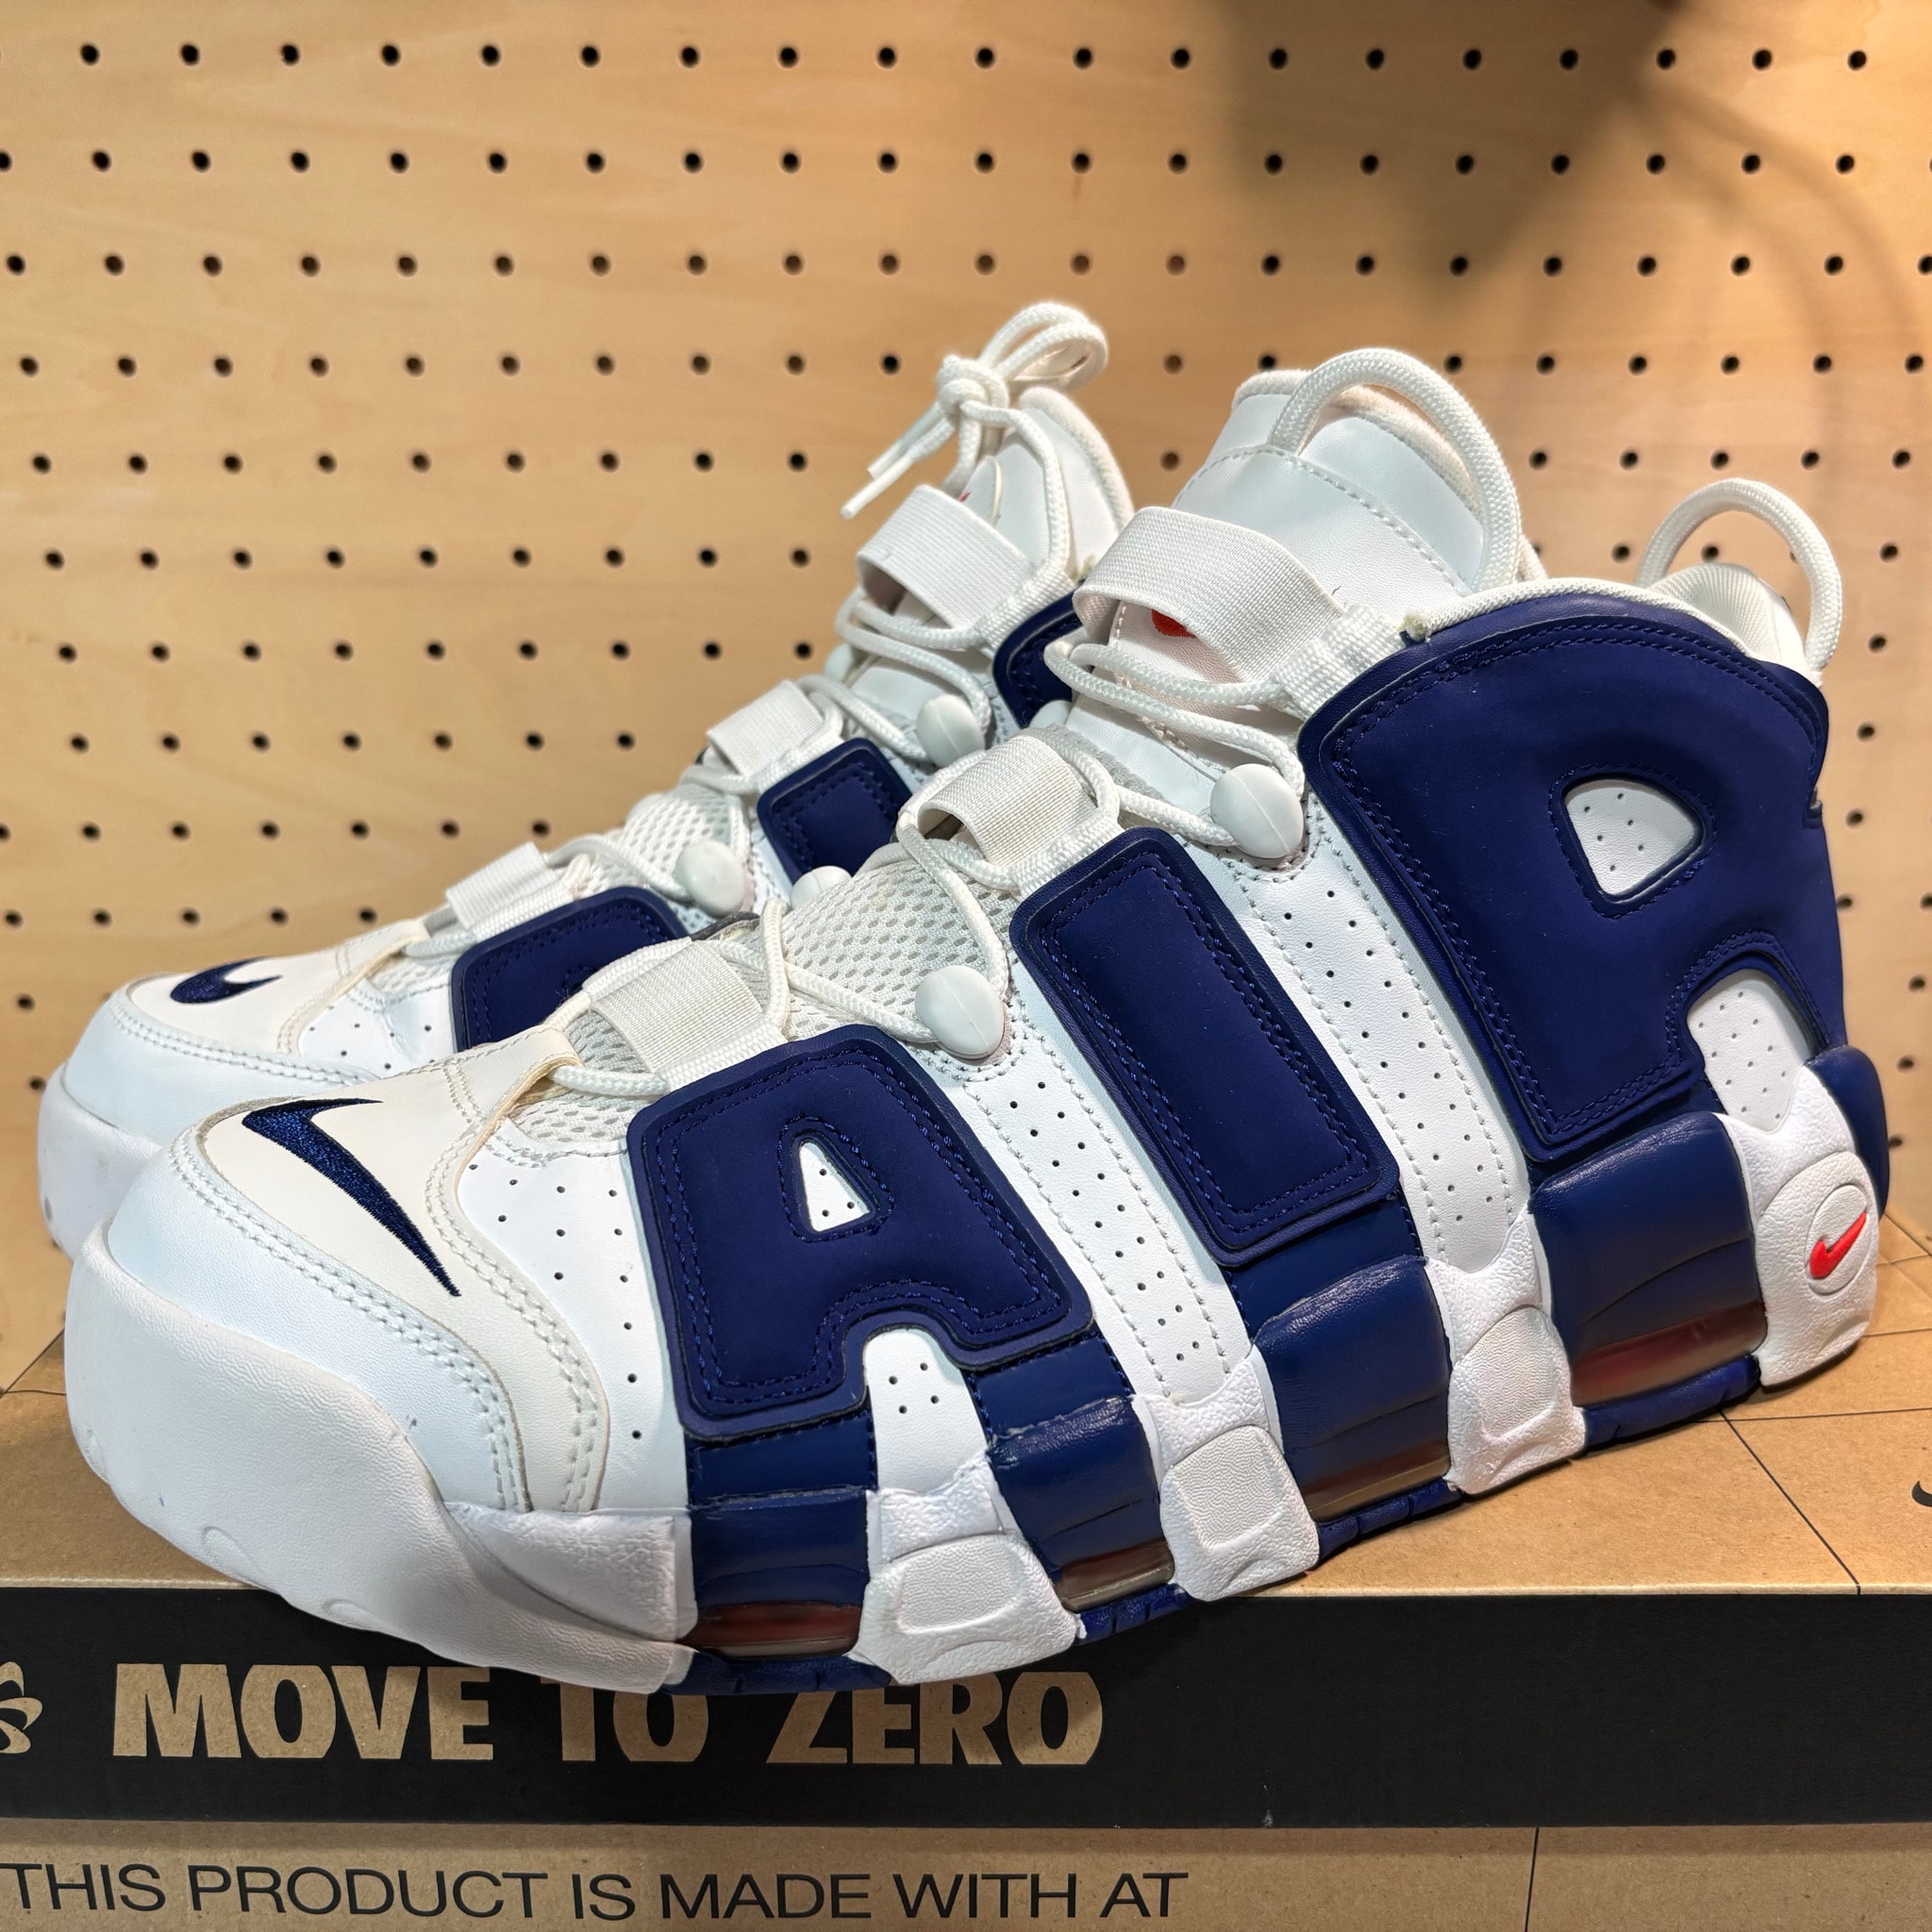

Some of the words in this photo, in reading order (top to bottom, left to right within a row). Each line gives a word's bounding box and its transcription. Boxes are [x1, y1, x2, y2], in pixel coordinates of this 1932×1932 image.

[113, 1662, 494, 1760] MOVE
[540, 1675, 709, 1762] TO
[766, 1671, 1104, 1765] ZERO
[0, 1862, 167, 1911] THIS
[188, 1864, 549, 1919] PRODUCT
[572, 1873, 637, 1921] IS
[659, 1873, 873, 1919] MADE
[892, 1873, 1077, 1919] WITH
[1099, 1872, 1190, 1919] AT
